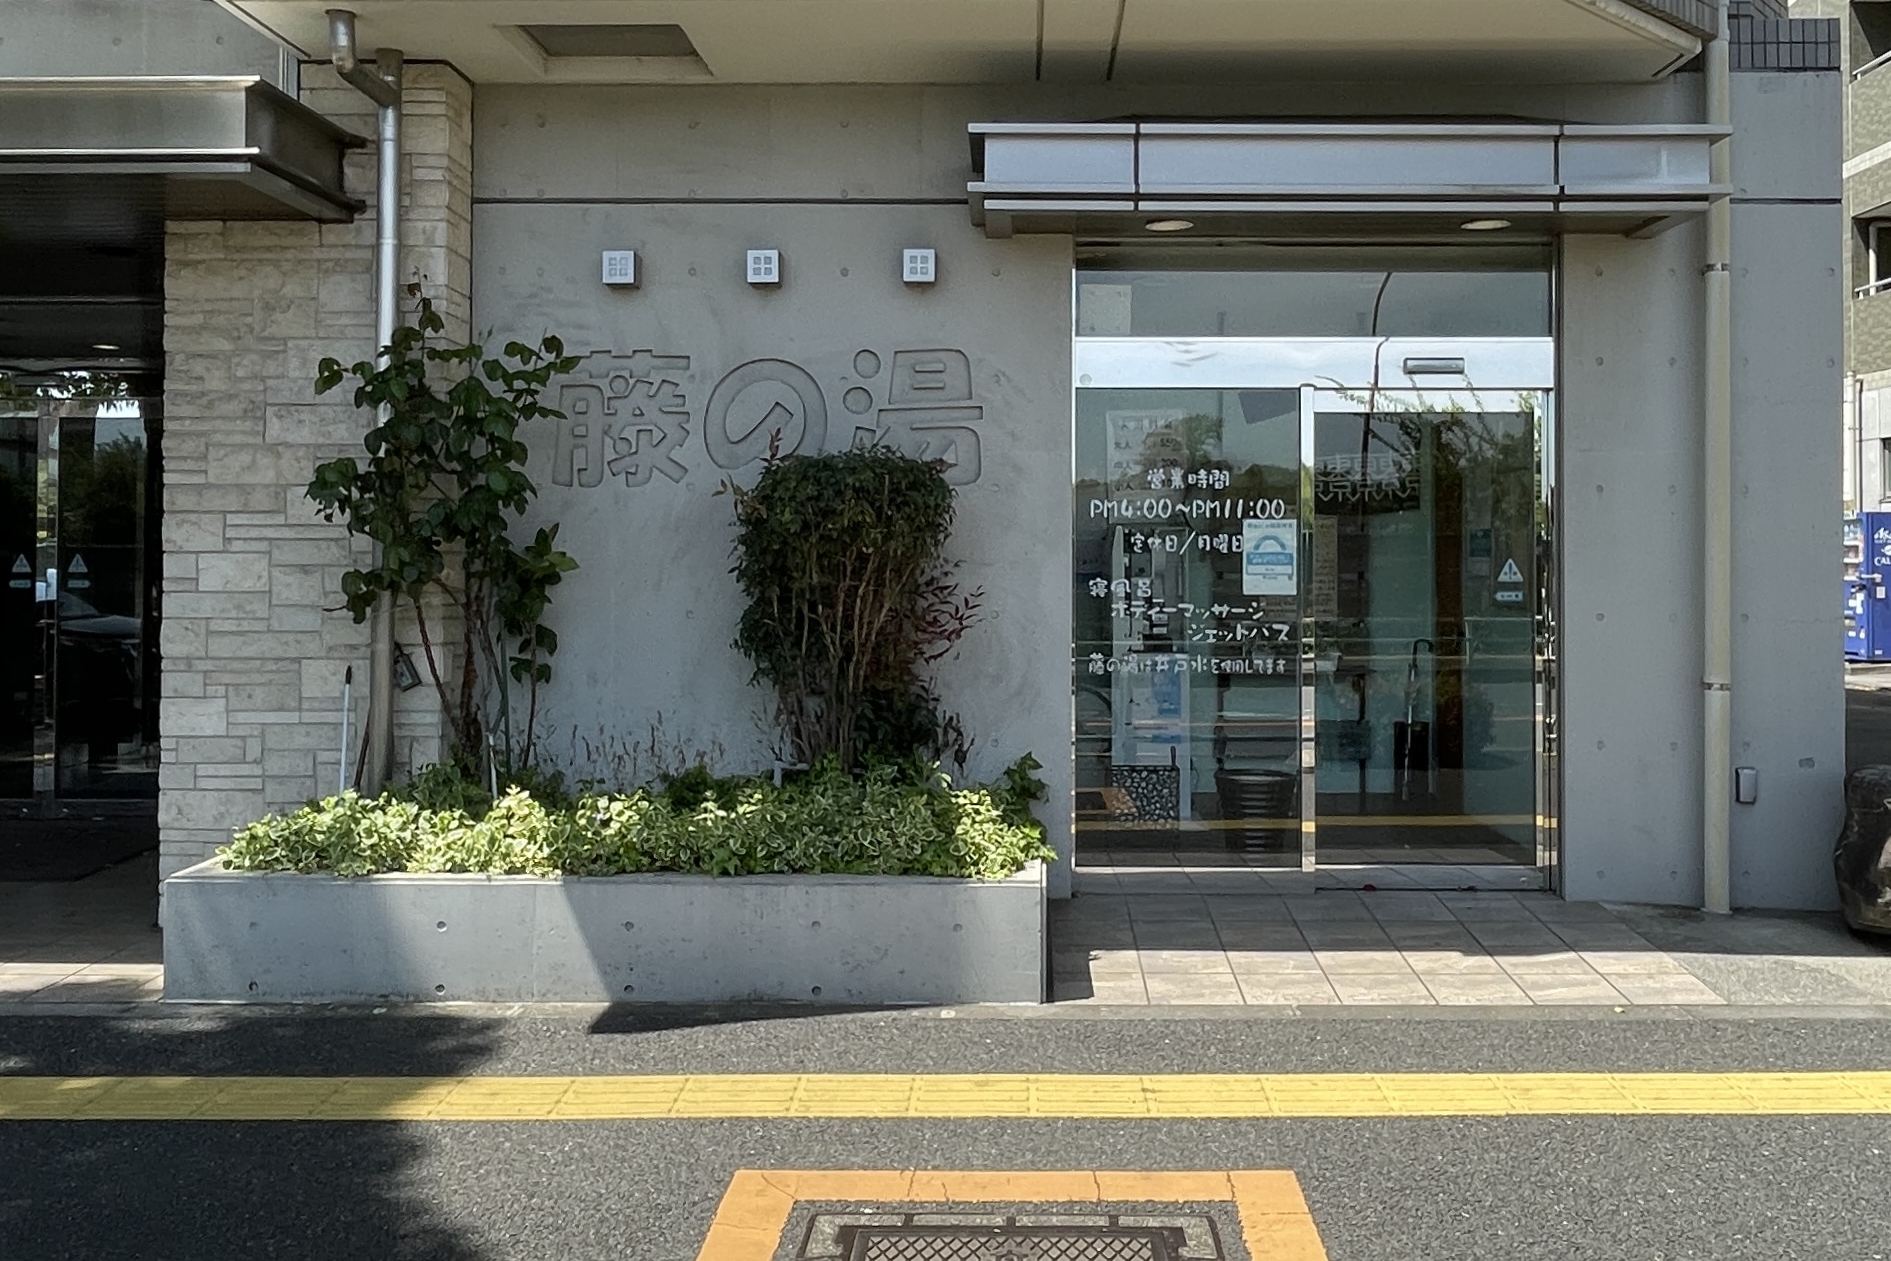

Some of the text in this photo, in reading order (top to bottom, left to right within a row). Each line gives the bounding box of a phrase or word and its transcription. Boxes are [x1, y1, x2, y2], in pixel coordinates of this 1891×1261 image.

[551, 348, 984, 488] 藤の湯
[1147, 468, 1230, 489] 営業時間
[1088, 577, 1151, 598] 寝風呂
